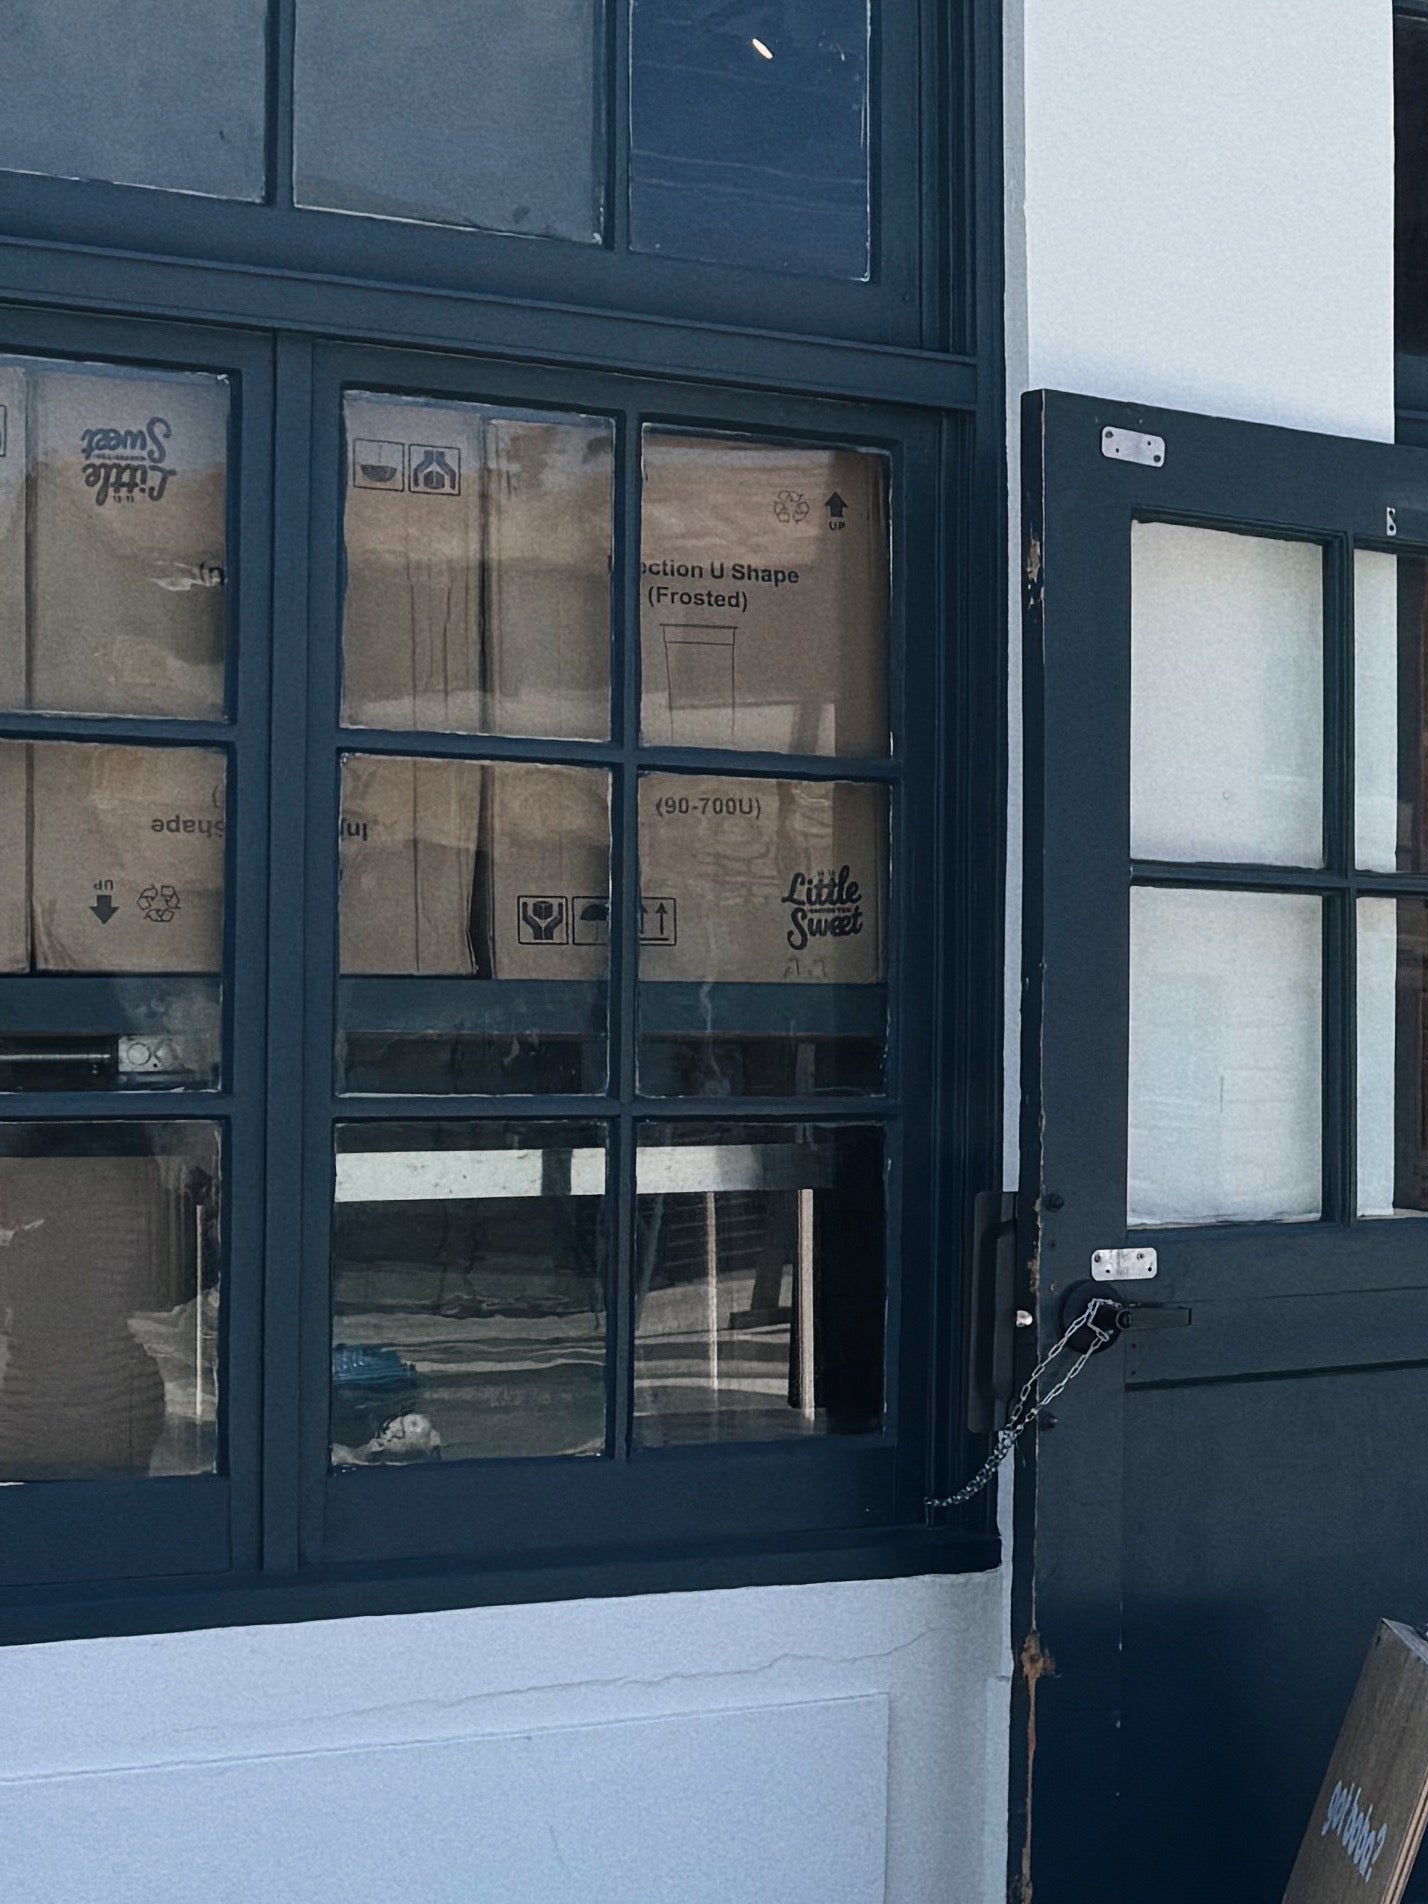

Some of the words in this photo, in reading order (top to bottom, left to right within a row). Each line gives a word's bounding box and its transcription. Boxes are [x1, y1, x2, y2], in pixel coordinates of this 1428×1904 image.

[81, 416, 172, 462] Sweet
[82, 462, 177, 506] Little
[829, 521, 845, 531] UP
[710, 561, 724, 580] U
[731, 563, 799, 587] Shape
[648, 586, 748, 613] (Frosted)
[655, 796, 762, 820] (90-700U)
[94, 879, 114, 891] UP
[781, 864, 862, 906] Little
[786, 906, 864, 951] Sweet
